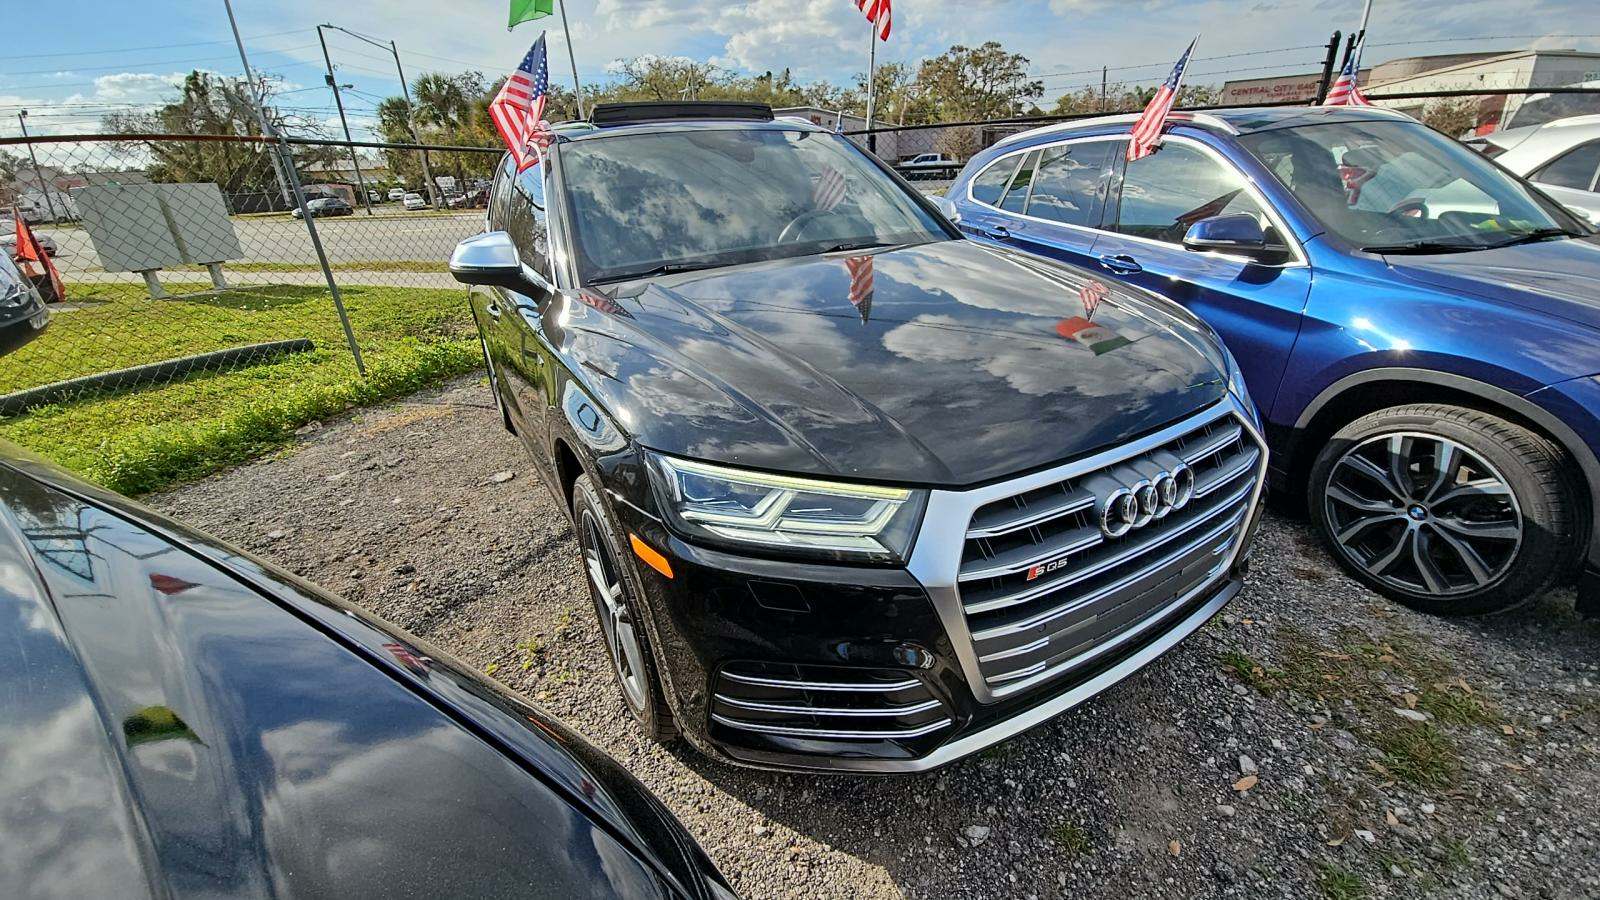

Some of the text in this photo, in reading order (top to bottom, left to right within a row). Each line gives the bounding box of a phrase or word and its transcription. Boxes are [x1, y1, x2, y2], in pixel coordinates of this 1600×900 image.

[1231, 86, 1269, 96] CENTRAL
[1273, 84, 1293, 93] CITY
[1034, 557, 1068, 576] SQ5
